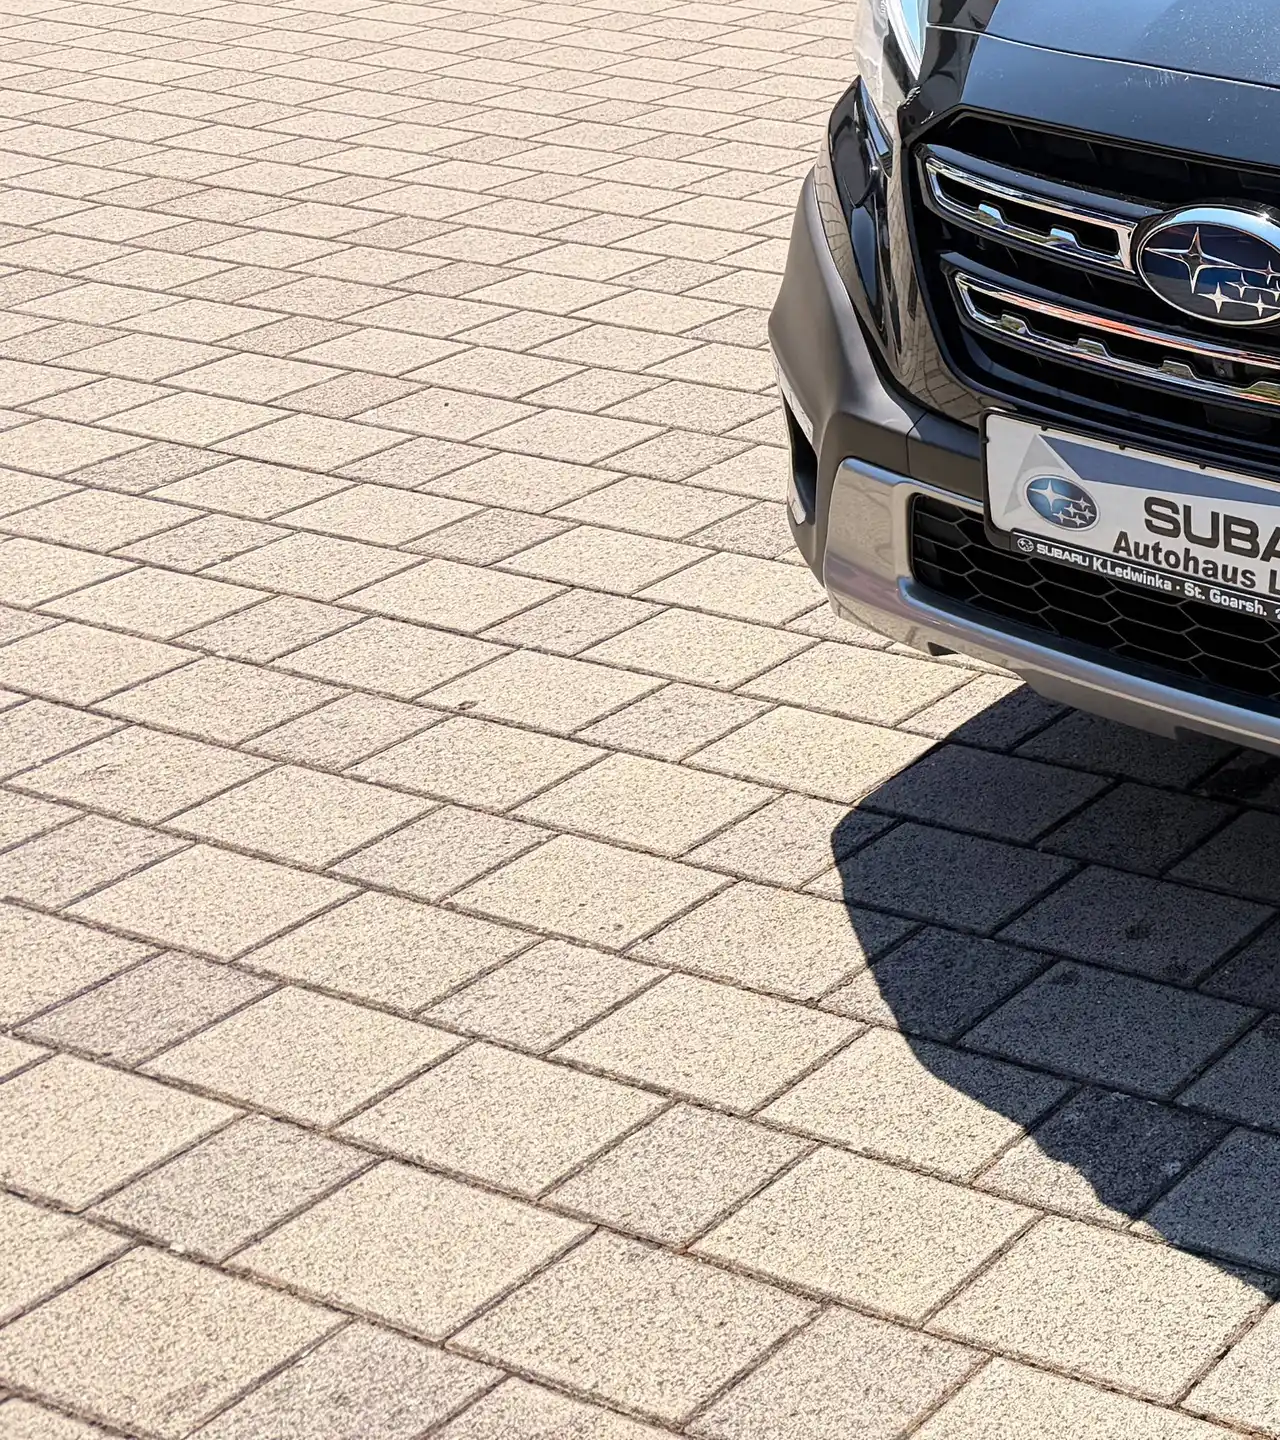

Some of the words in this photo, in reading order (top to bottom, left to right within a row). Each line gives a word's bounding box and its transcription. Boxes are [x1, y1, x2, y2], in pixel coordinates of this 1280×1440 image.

[1036, 542, 1089, 568] SUBARU
[1092, 555, 1173, 592] K.Ledwinka
[1184, 581, 1206, 601] St.
[1209, 588, 1268, 617] Goarsh.
[1112, 531, 1257, 589] Autohaus
